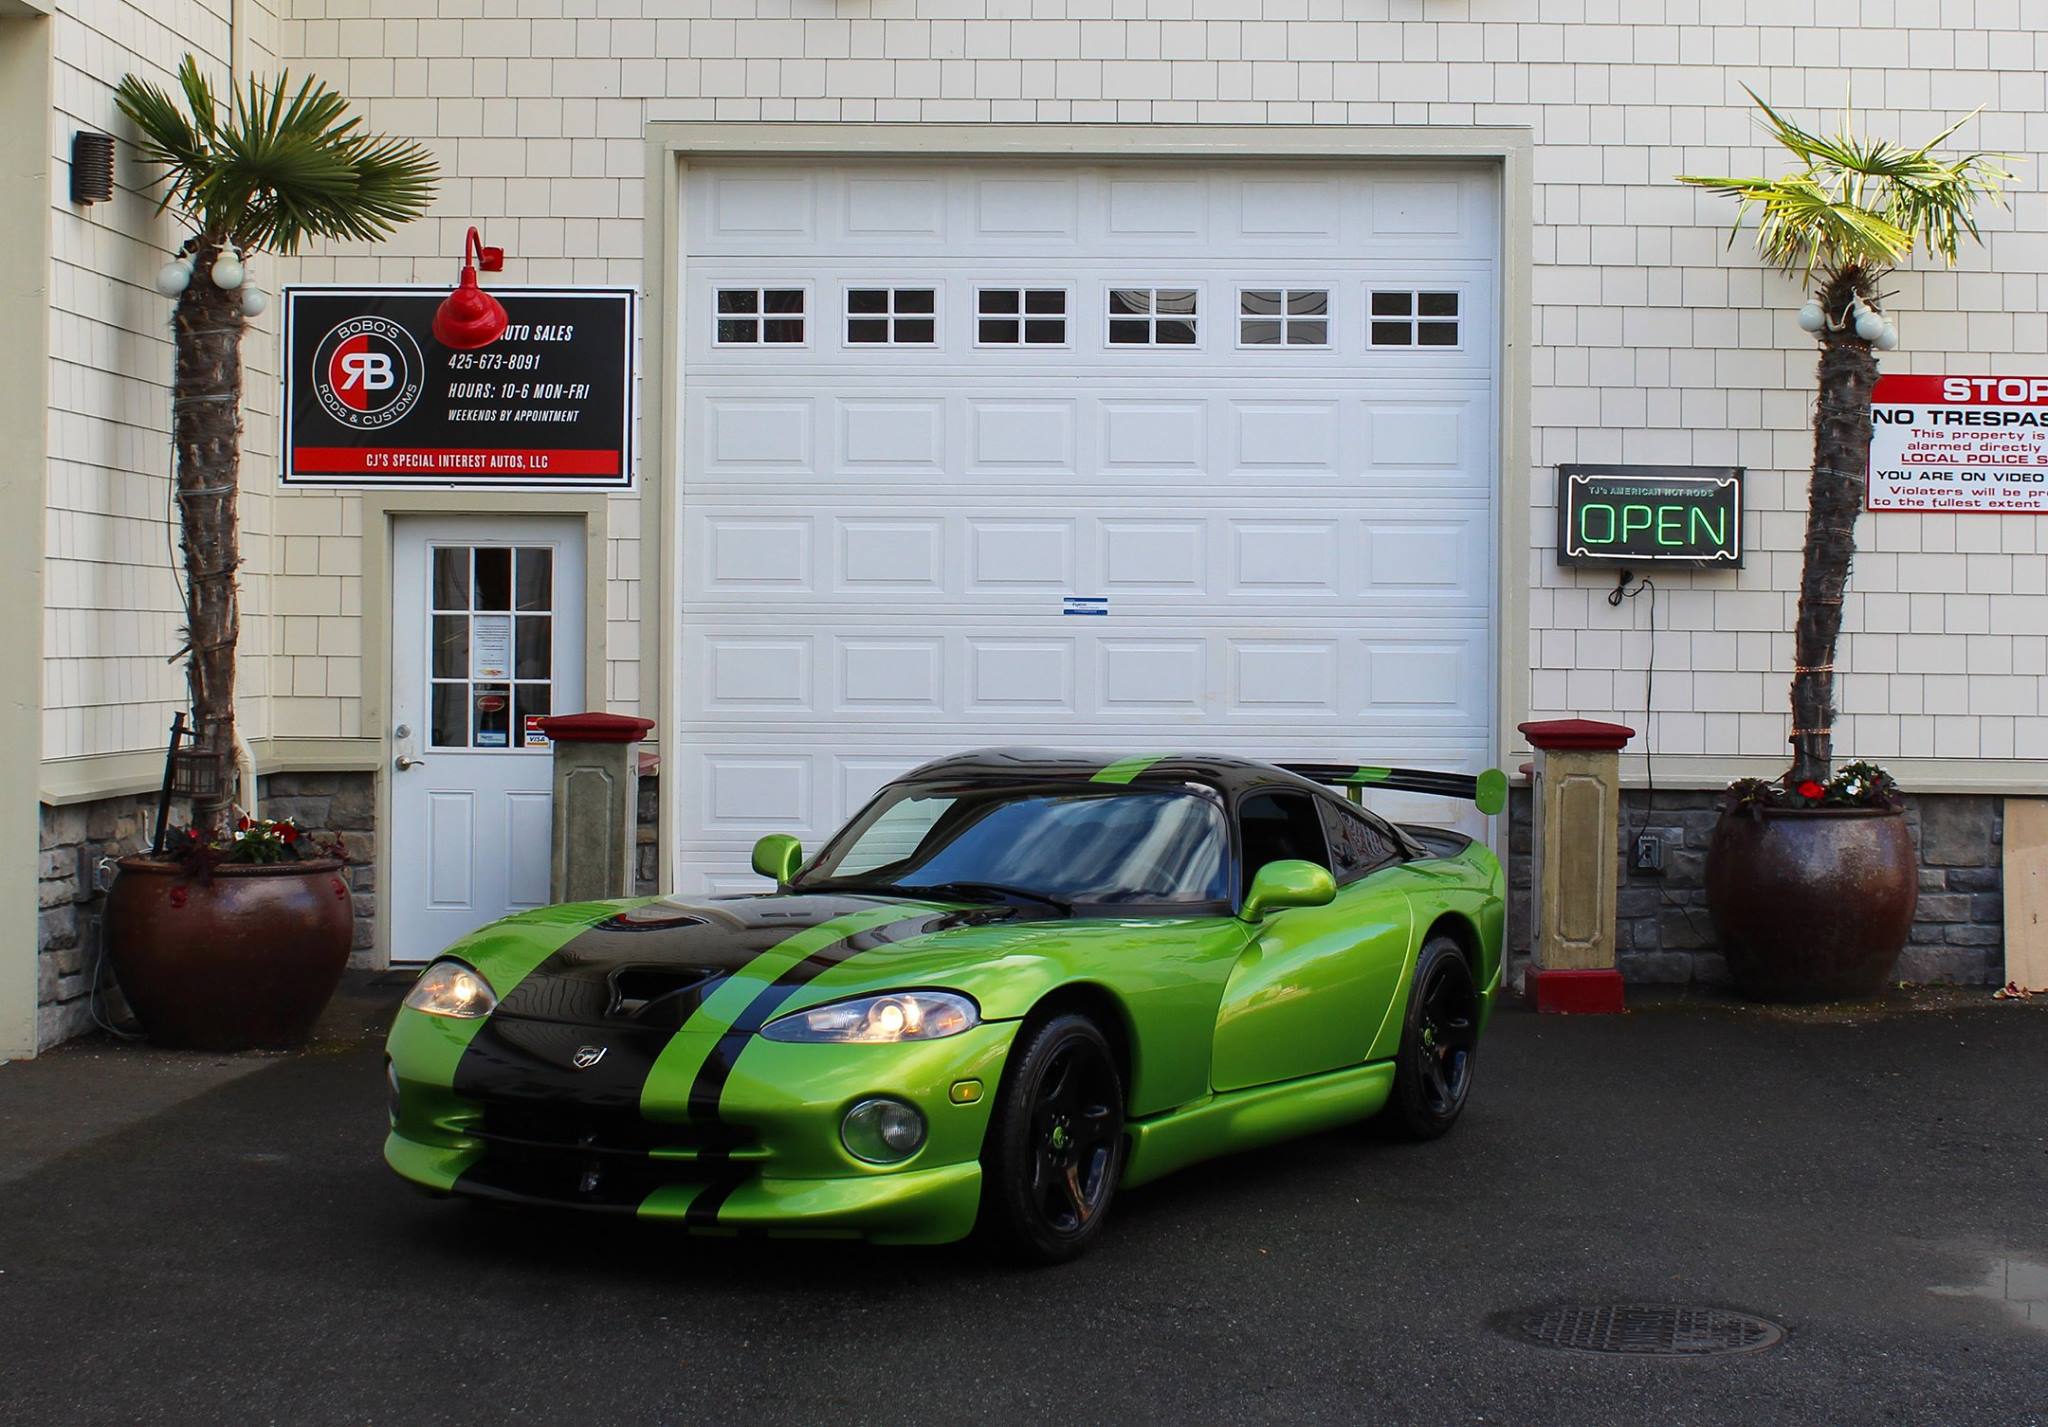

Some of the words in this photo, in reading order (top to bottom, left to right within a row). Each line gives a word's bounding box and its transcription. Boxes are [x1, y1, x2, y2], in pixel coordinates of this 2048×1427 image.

[338, 320, 400, 339] BOBO'S
[500, 324, 530, 341] UTO
[534, 325, 574, 341] SALES
[448, 354, 541, 370] 425-673-8091
[448, 382, 496, 399] HOURS:
[501, 383, 530, 399] 10-6
[533, 384, 590, 400] MON-FRI
[1943, 378, 2048, 402] STOP
[320, 383, 348, 418] RODS
[349, 414, 358, 423] &
[362, 383, 418, 425] CUSTOMS
[448, 409, 498, 421] WEEKENDS
[500, 410, 513, 421] BY
[514, 410, 580, 423] APPOINTMENT
[1873, 409, 1914, 425] NO
[1911, 429, 1944, 439] This
[1952, 431, 2025, 442] property
[2032, 431, 2046, 440] is
[1907, 441, 1972, 451] alarmed
[1979, 442, 2042, 454] directly
[366, 453, 389, 467] CJ'S
[392, 454, 435, 467] SPECIAL
[438, 454, 487, 468] INTEREST
[490, 455, 526, 469] AUTOS,
[529, 455, 548, 468] LLC
[1901, 453, 1959, 463] LOCAL
[1967, 454, 2029, 464] POLICE
[1876, 470, 1912, 480] YOU
[1919, 471, 1953, 480] ARE
[1961, 472, 1986, 481] ON
[1993, 472, 2044, 482] VIDEO
[1609, 486, 1661, 496] AMERICAN
[1664, 487, 1683, 497] HOT
[1686, 488, 1715, 498] RODS
[1971, 488, 1995, 496] will
[2002, 488, 2021, 497] be
[2028, 490, 2048, 498] pr
[1873, 497, 1892, 506] to
[1898, 497, 1925, 507] the
[1932, 498, 1982, 508] fullest
[1988, 500, 2041, 508] extent
[1580, 503, 1726, 546] OPEN
